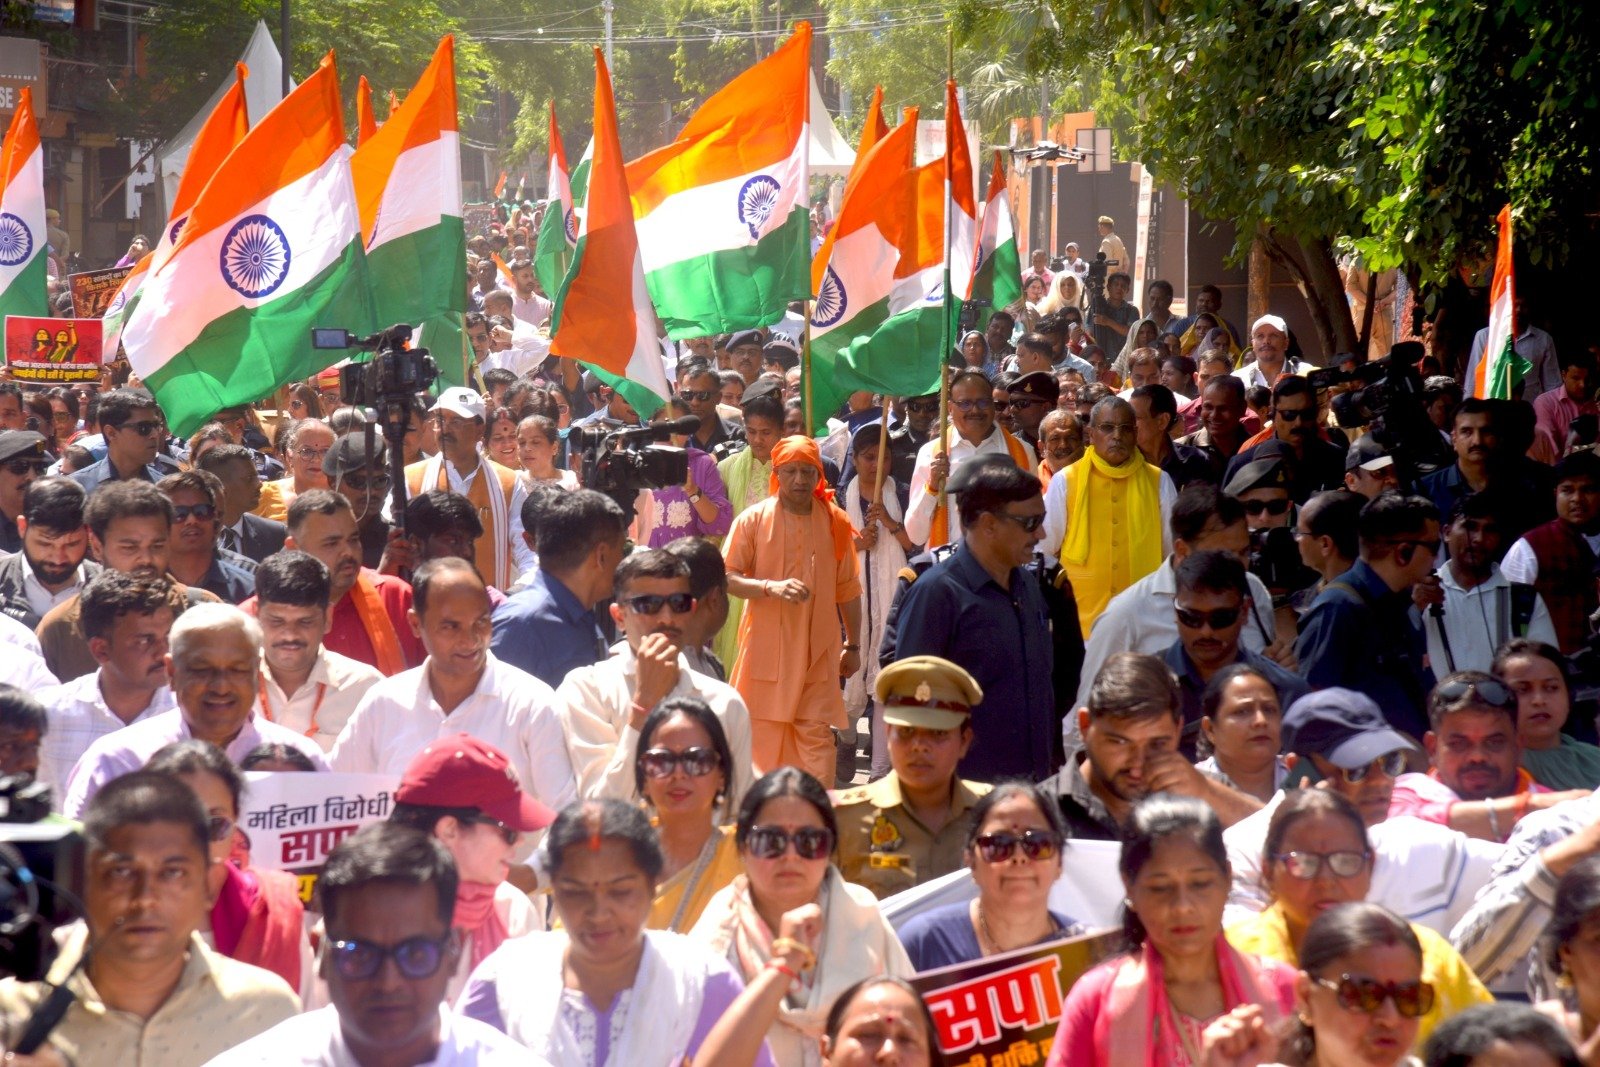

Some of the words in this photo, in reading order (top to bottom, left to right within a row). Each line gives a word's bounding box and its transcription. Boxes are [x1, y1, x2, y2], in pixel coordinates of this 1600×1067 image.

[76, 277, 92, 287] 230
[248, 803, 319, 829] महिला
[323, 791, 391, 822] विरोधी
[280, 825, 359, 863] सप
[922, 953, 1062, 1055] सपा
